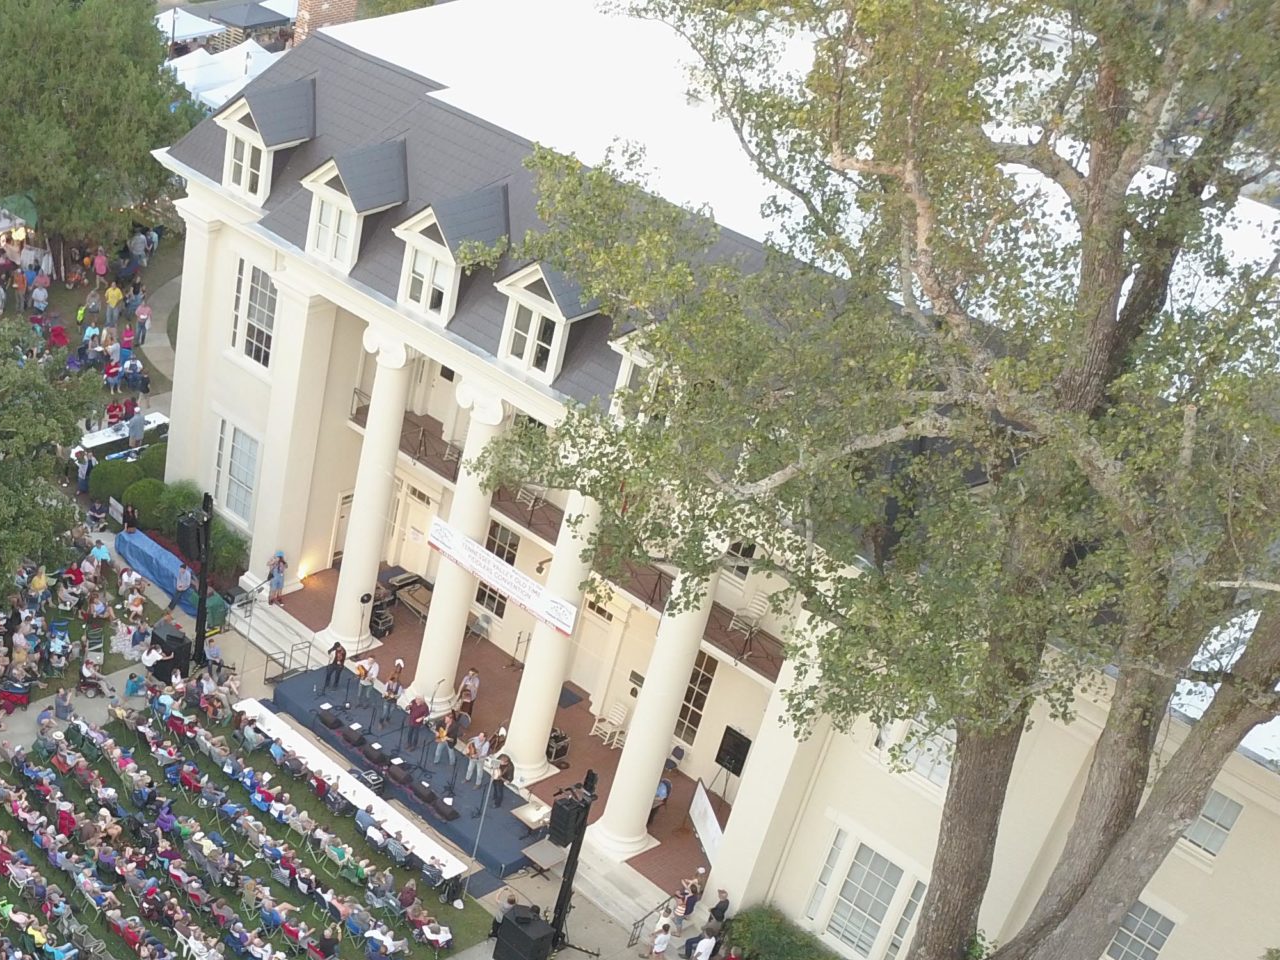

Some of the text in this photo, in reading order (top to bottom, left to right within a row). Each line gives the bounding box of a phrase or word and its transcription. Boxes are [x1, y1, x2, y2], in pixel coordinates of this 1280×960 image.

[461, 541, 490, 565] TENNESSEE
[492, 562, 512, 579] VALLEY
[514, 576, 527, 589] OLD
[527, 584, 540, 598] TIME
[467, 554, 492, 574] FIDDLERS
[493, 571, 531, 599] CONVENTION
